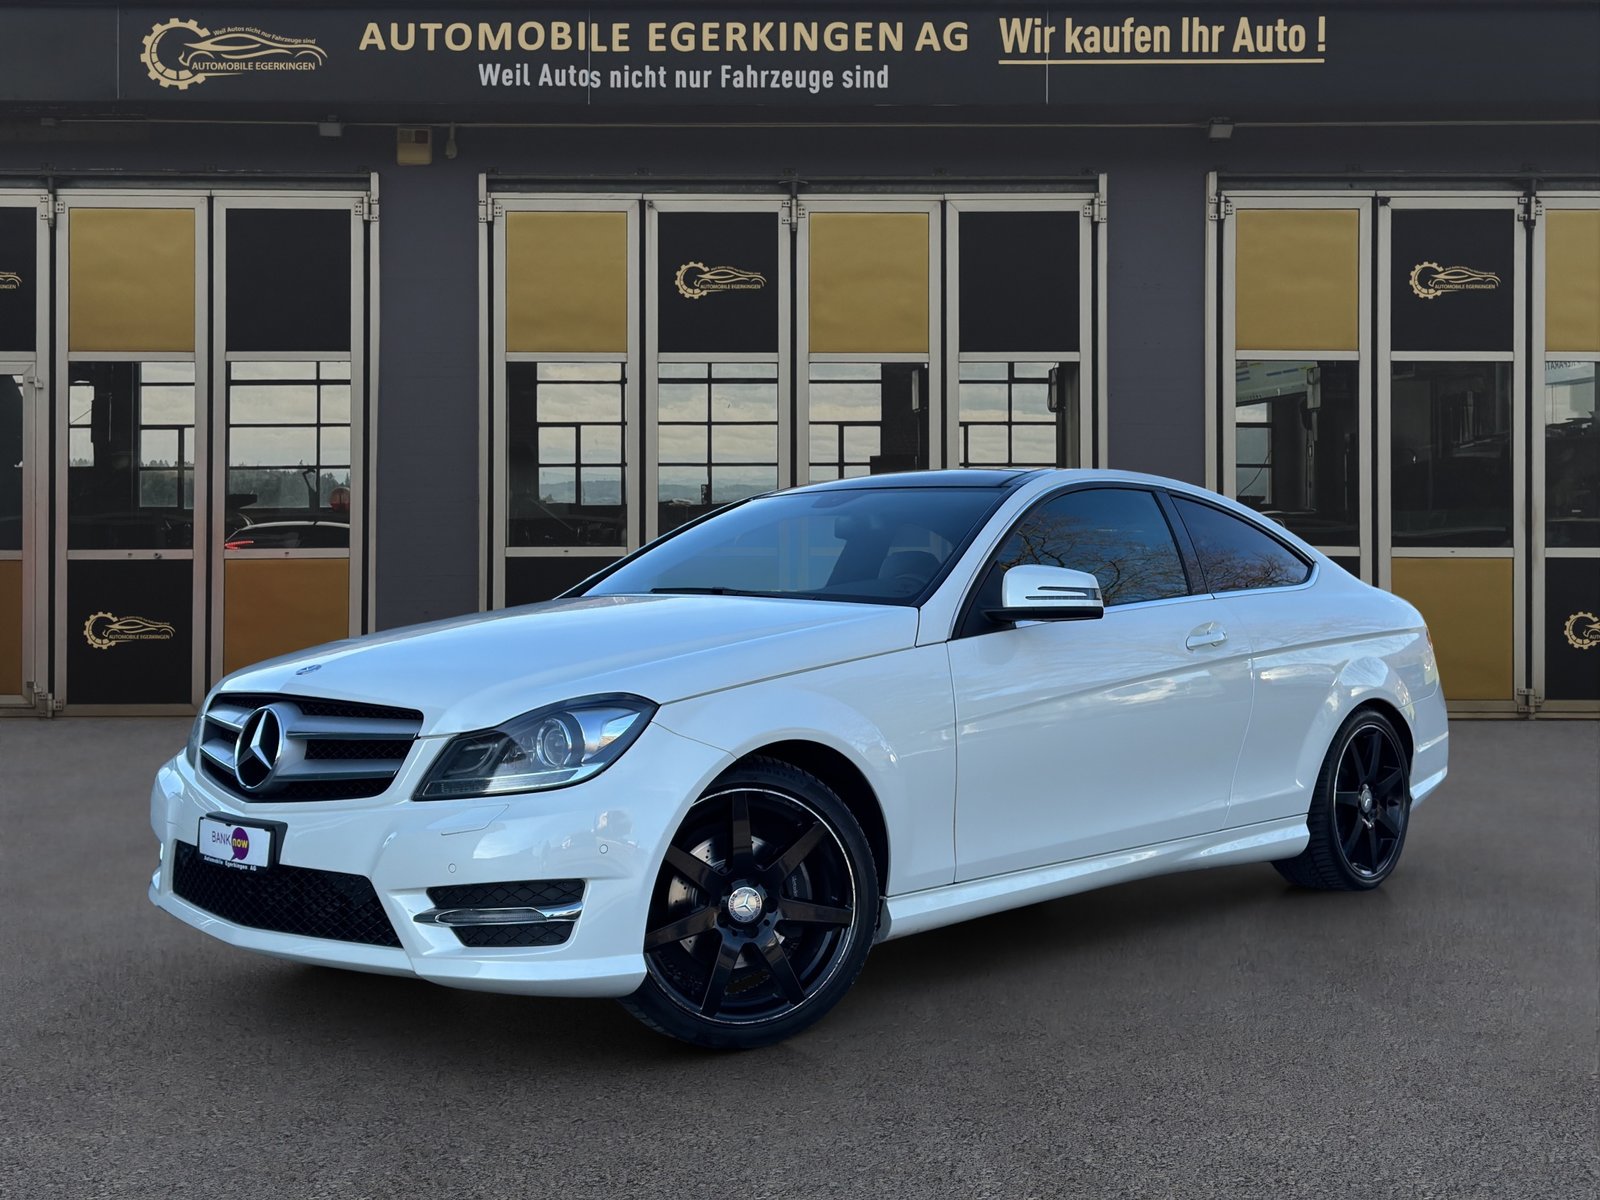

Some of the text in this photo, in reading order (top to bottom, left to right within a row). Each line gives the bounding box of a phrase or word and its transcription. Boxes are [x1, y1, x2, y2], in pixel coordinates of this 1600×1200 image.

[358, 21, 969, 52] AUTOMOBILE EGERKINGEN AG
[999, 17, 1056, 54] Wir
[1064, 16, 1171, 54] kaufen
[1181, 16, 1225, 53] Ihr
[1231, 16, 1307, 53] Auto
[191, 61, 316, 71] AUTOMOBILE EGERKINGEN
[478, 63, 889, 94] Weil Autos nicht nur Fahrzeuge sind
[212, 831, 248, 849] BANK now
